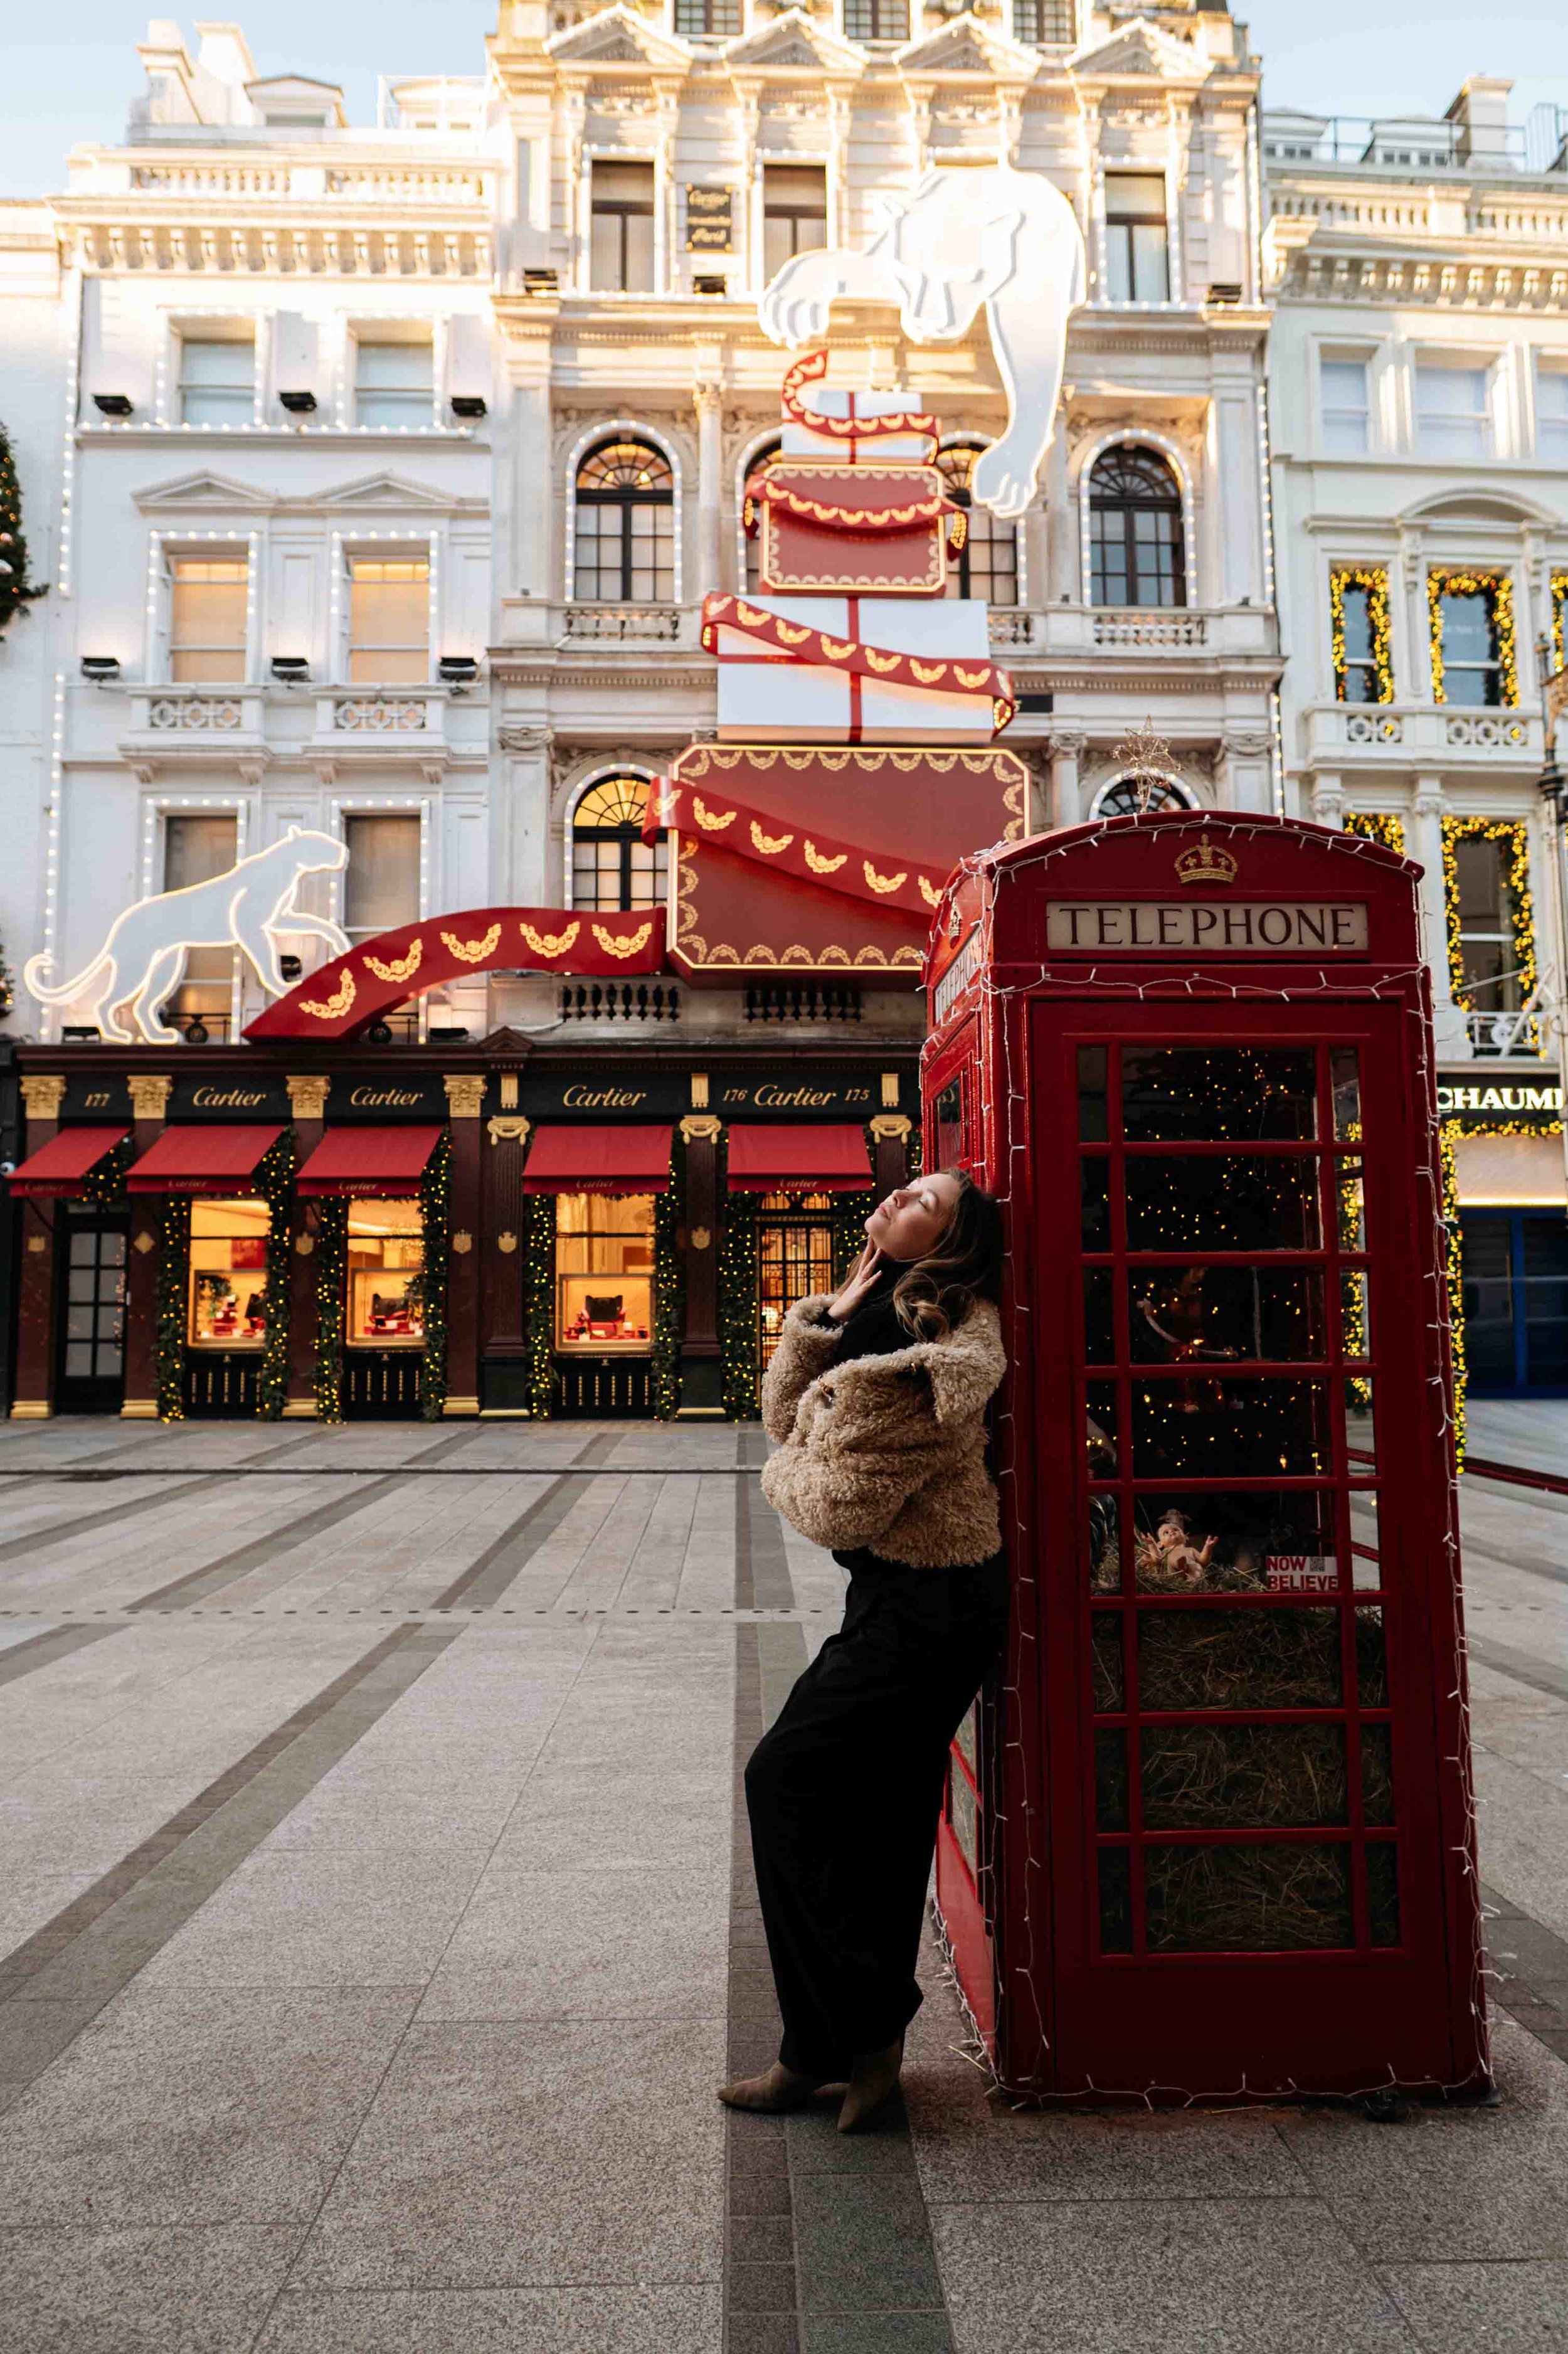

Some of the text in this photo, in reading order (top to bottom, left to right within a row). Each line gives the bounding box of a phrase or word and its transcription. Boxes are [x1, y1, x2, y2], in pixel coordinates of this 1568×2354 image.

[1059, 907, 1356, 945] TELEPHONE
[193, 1086, 267, 1106] Cartier
[351, 1086, 424, 1106] Cartier
[563, 1084, 647, 1106] Cartier
[723, 1083, 870, 1106] 176 Cartier 175
[339, 1181, 378, 1190] Cartier
[780, 1179, 819, 1189] Cartier
[1266, 1556, 1306, 1572] NOW
[1268, 1575, 1338, 1591] BELIEVE
